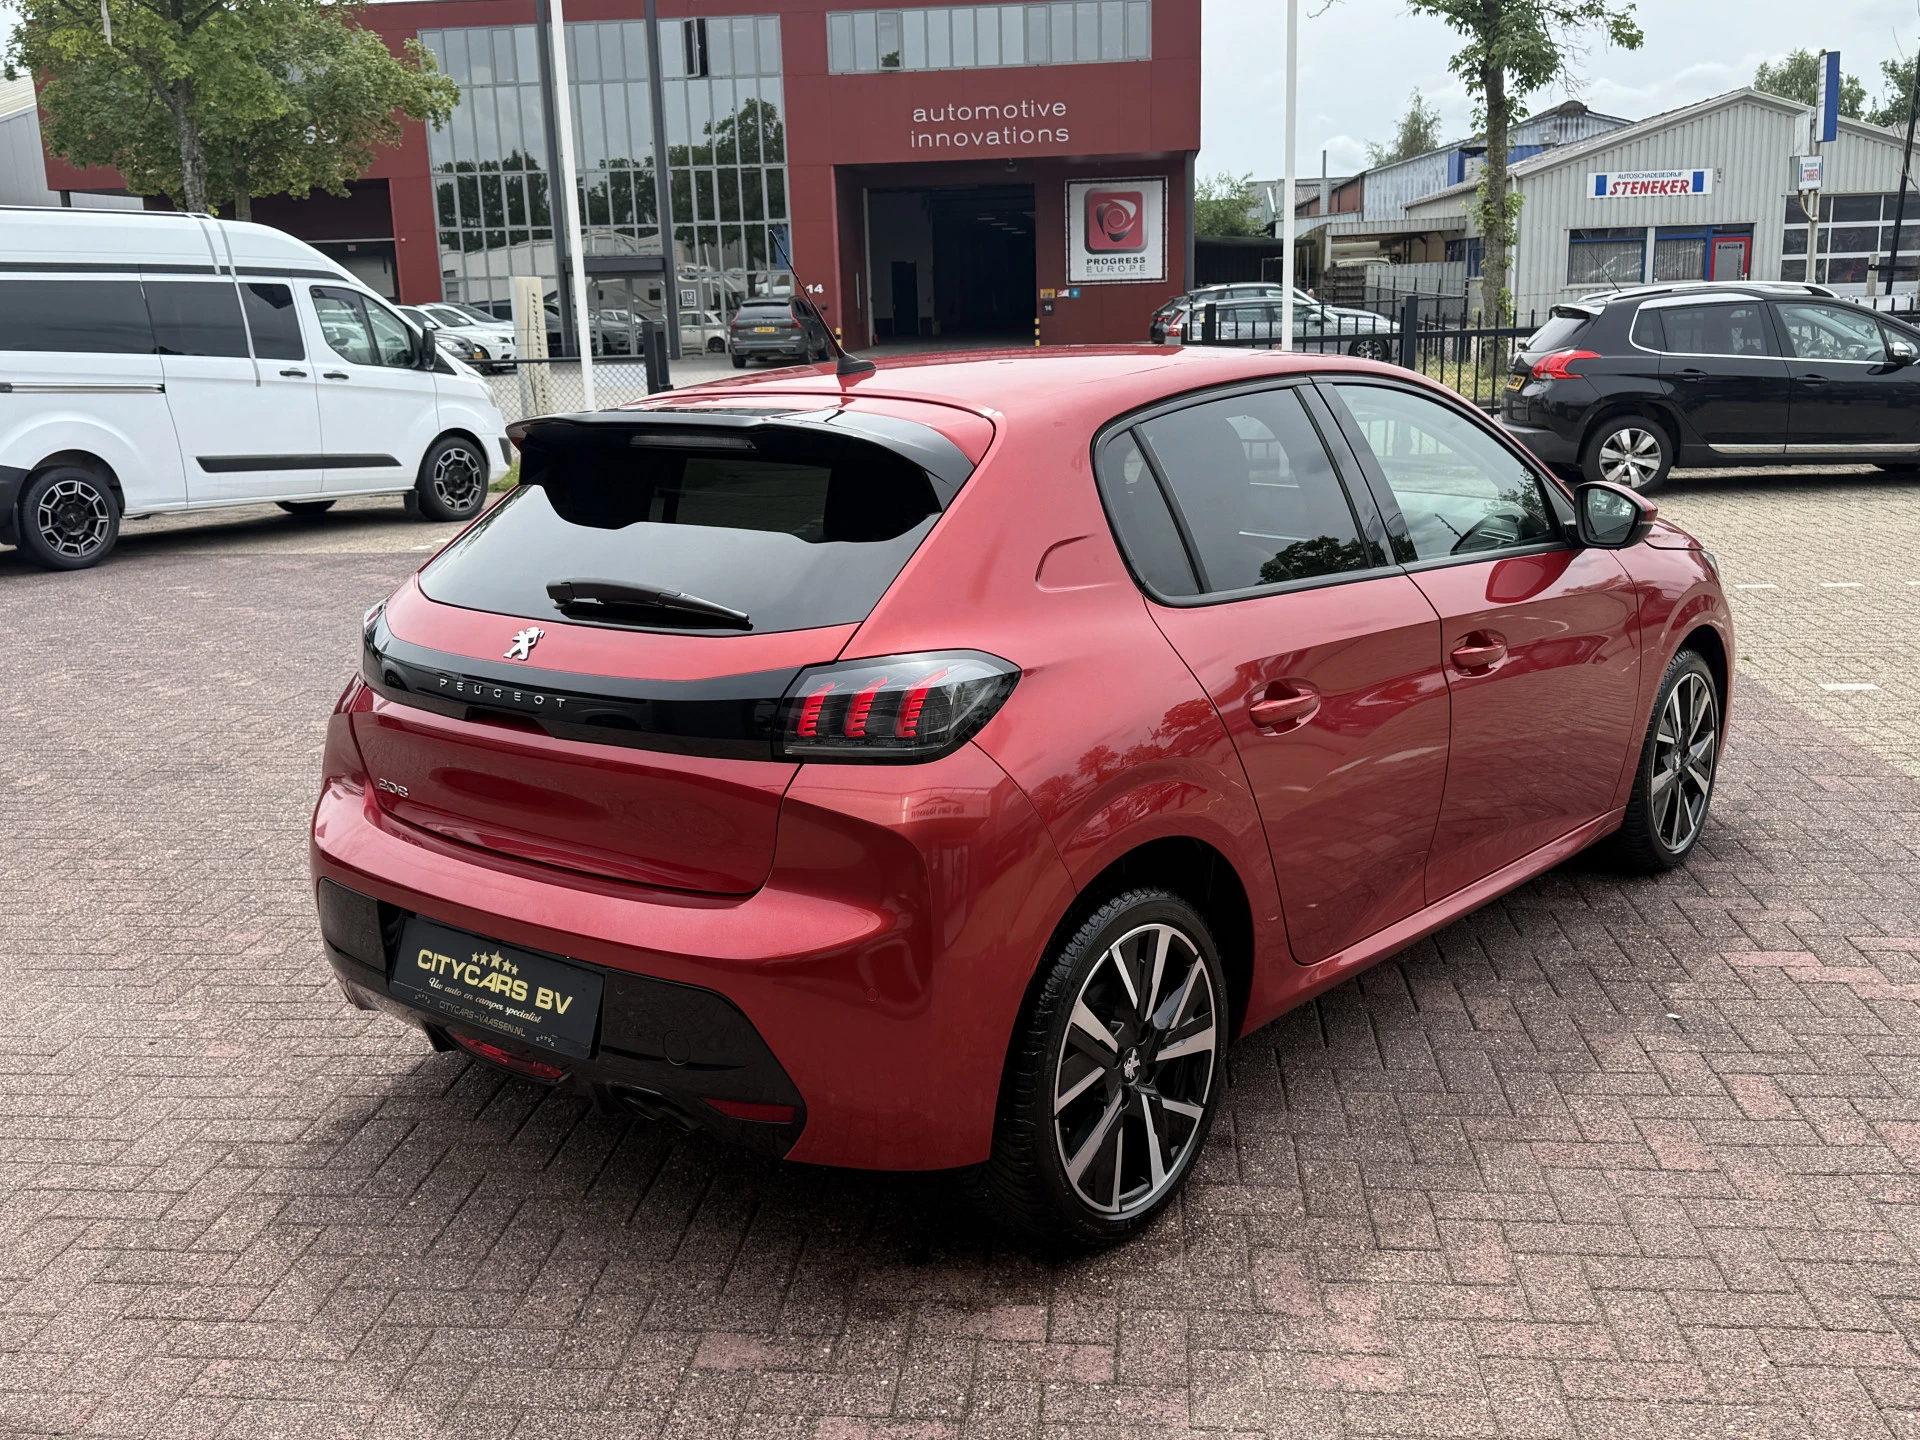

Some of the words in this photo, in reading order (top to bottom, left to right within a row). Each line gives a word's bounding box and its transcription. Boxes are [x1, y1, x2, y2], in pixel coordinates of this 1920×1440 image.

[913, 100, 1067, 123] automotive
[911, 126, 1070, 148] innovations
[1609, 179, 1690, 196] STENEKER
[1086, 256, 1146, 266] PROGRESS
[1086, 264, 1146, 274] EUROPE
[806, 283, 824, 294] 14
[439, 678, 567, 708] PEUGEOT
[378, 777, 409, 798] 208
[417, 949, 529, 1002] CITYCARS
[534, 986, 573, 1015] BV
[428, 976, 443, 990] Uw
[444, 985, 462, 997] auto
[463, 991, 474, 1001] en
[475, 995, 504, 1012] camper
[505, 1005, 542, 1024] specialist
